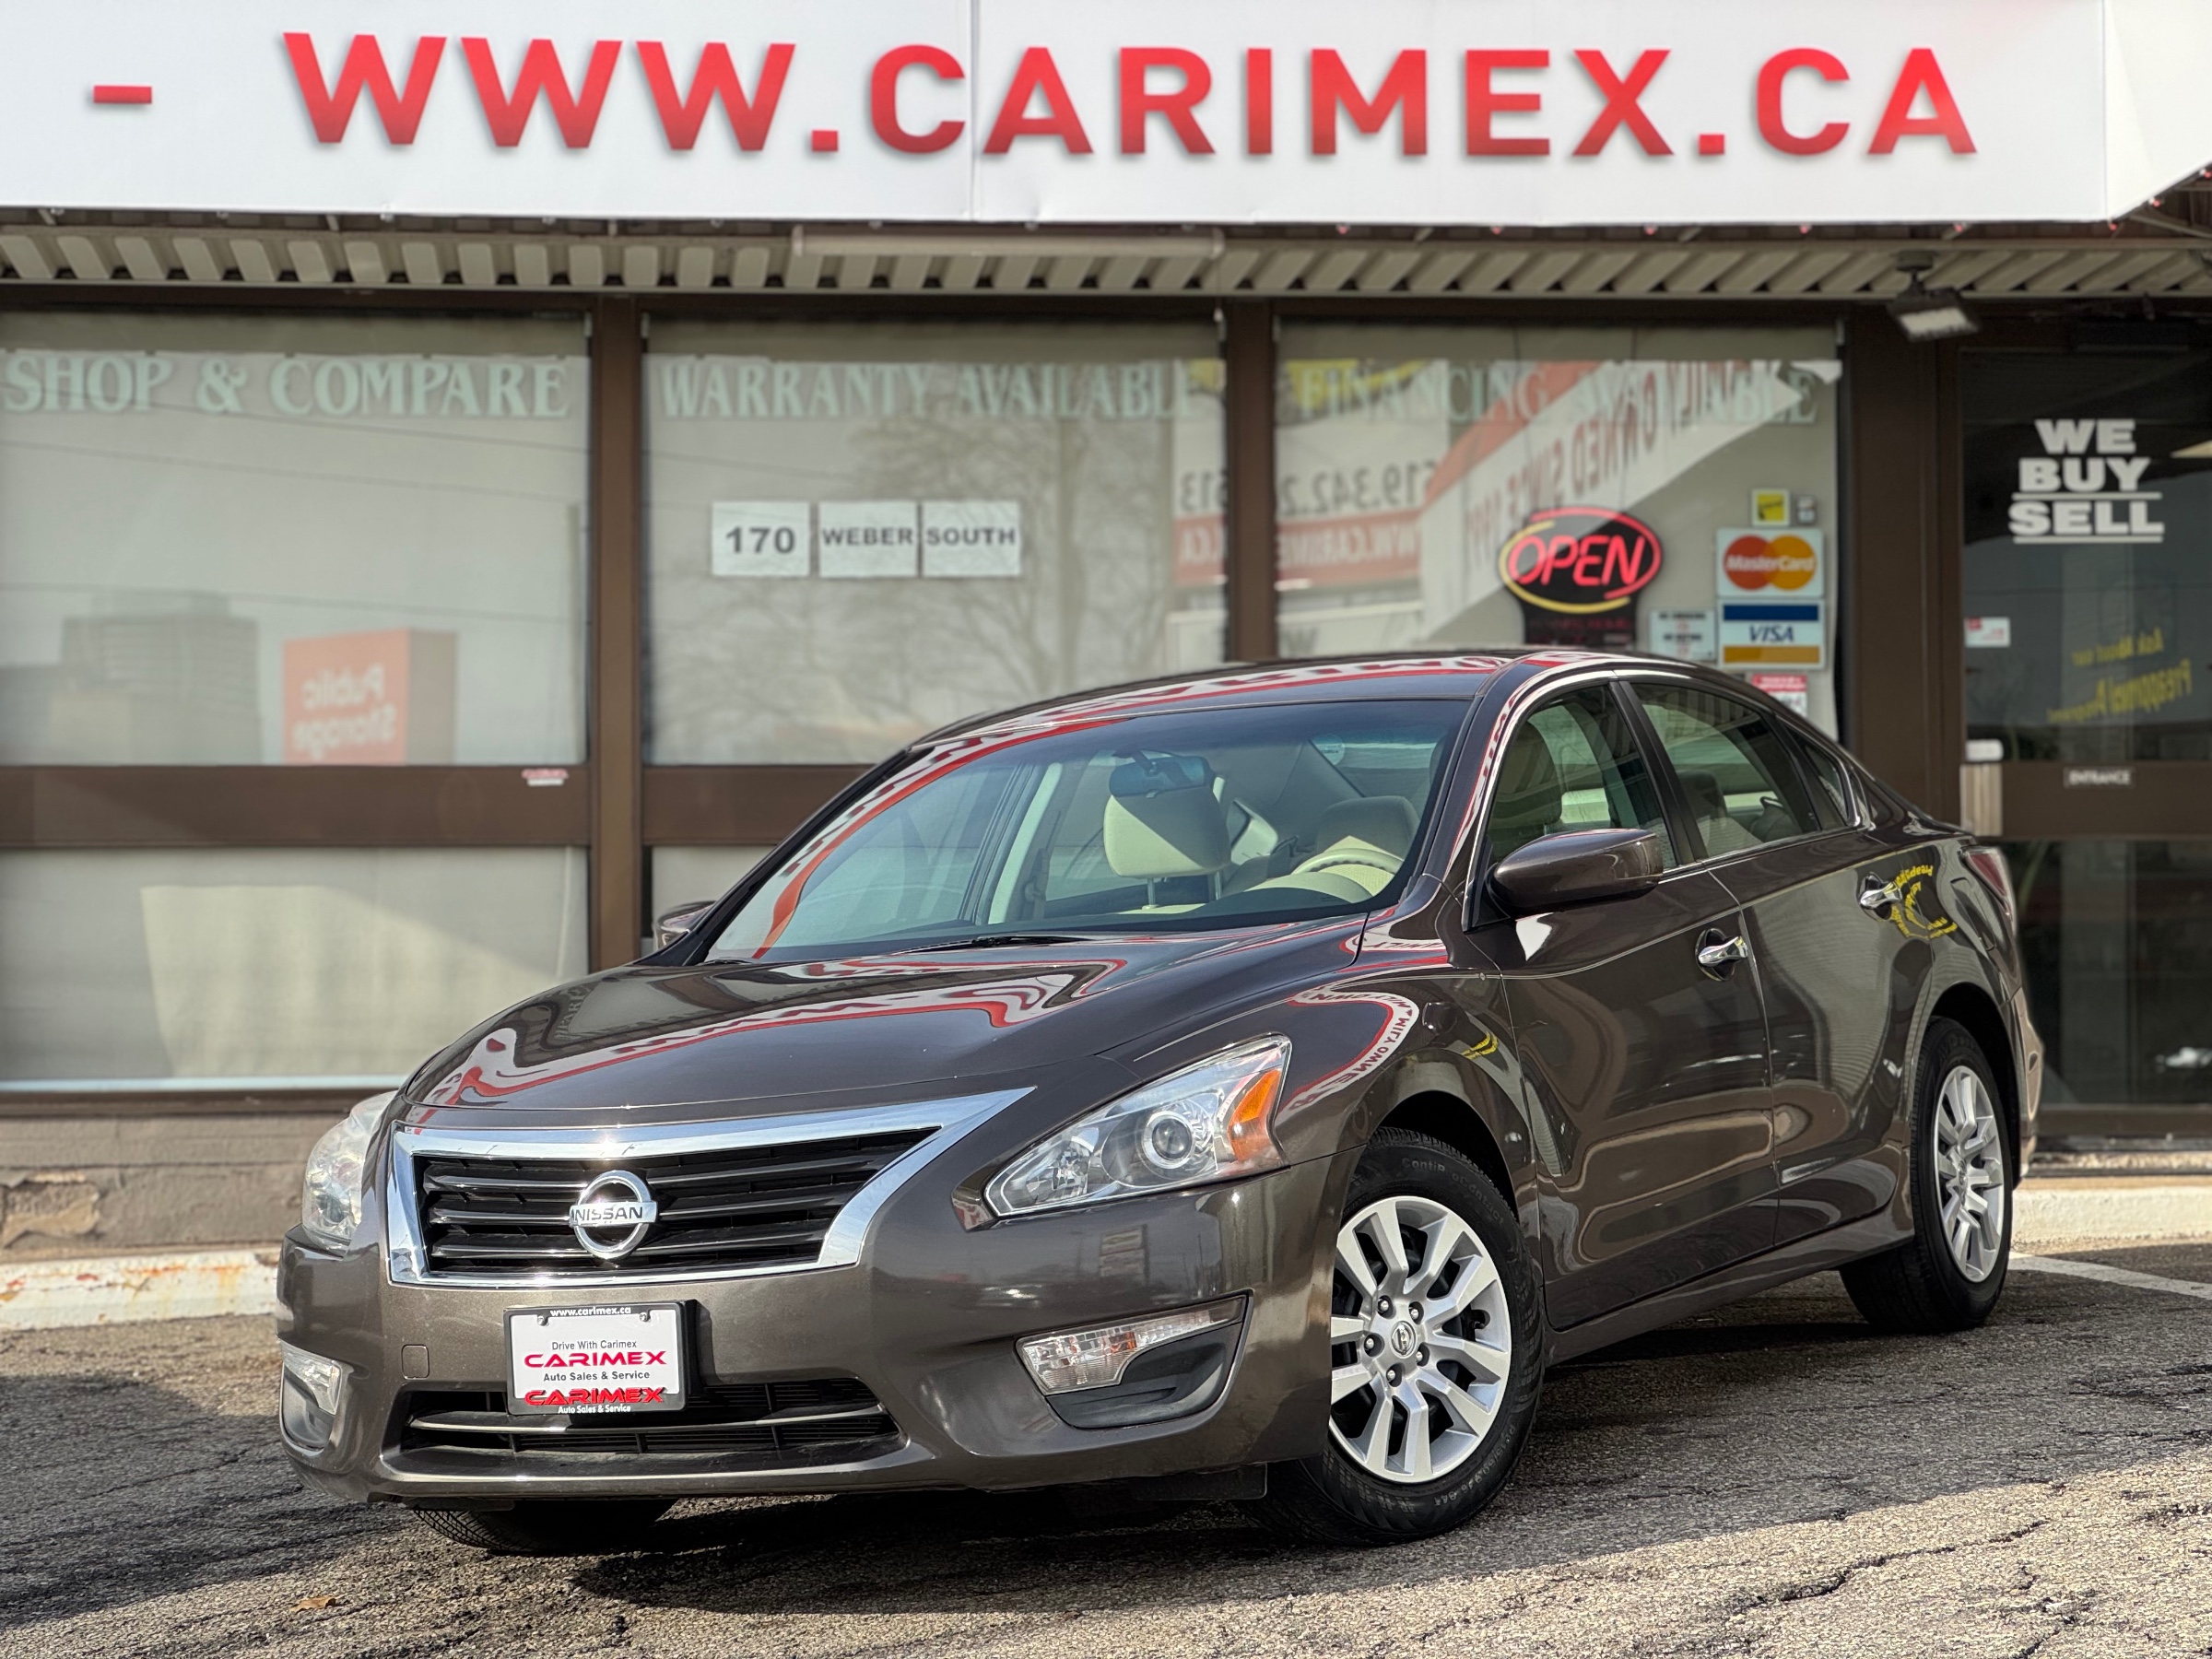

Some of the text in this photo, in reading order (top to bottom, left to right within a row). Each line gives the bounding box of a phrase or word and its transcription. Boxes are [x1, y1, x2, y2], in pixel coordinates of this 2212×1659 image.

[283, 32, 1978, 158] WWW.CARIMEX.CA
[5, 356, 570, 418] SHOP & COMPARE
[661, 362, 934, 418] WARRANTY
[2036, 419, 2136, 453] WE
[2019, 457, 2150, 491] BUY
[2008, 501, 2164, 535] SELL
[725, 526, 795, 554] 170
[822, 527, 914, 546] WEBER
[924, 527, 1017, 546] SOUTH
[1508, 535, 1646, 586] OPEN
[1725, 555, 1816, 571] MasterCard
[1749, 626, 1794, 642] VISA
[573, 1206, 643, 1221] NISSAN
[550, 1306, 631, 1317] www.carimex.ca
[552, 1339, 637, 1350] Drive With Carimex
[524, 1350, 666, 1368] CARIMEX
[543, 1370, 651, 1382] Auto Sales & Service
[524, 1386, 665, 1406] CARIMEX
[558, 1405, 575, 1415] Auto
[576, 1405, 596, 1414] Sales
[605, 1404, 631, 1414] Service
